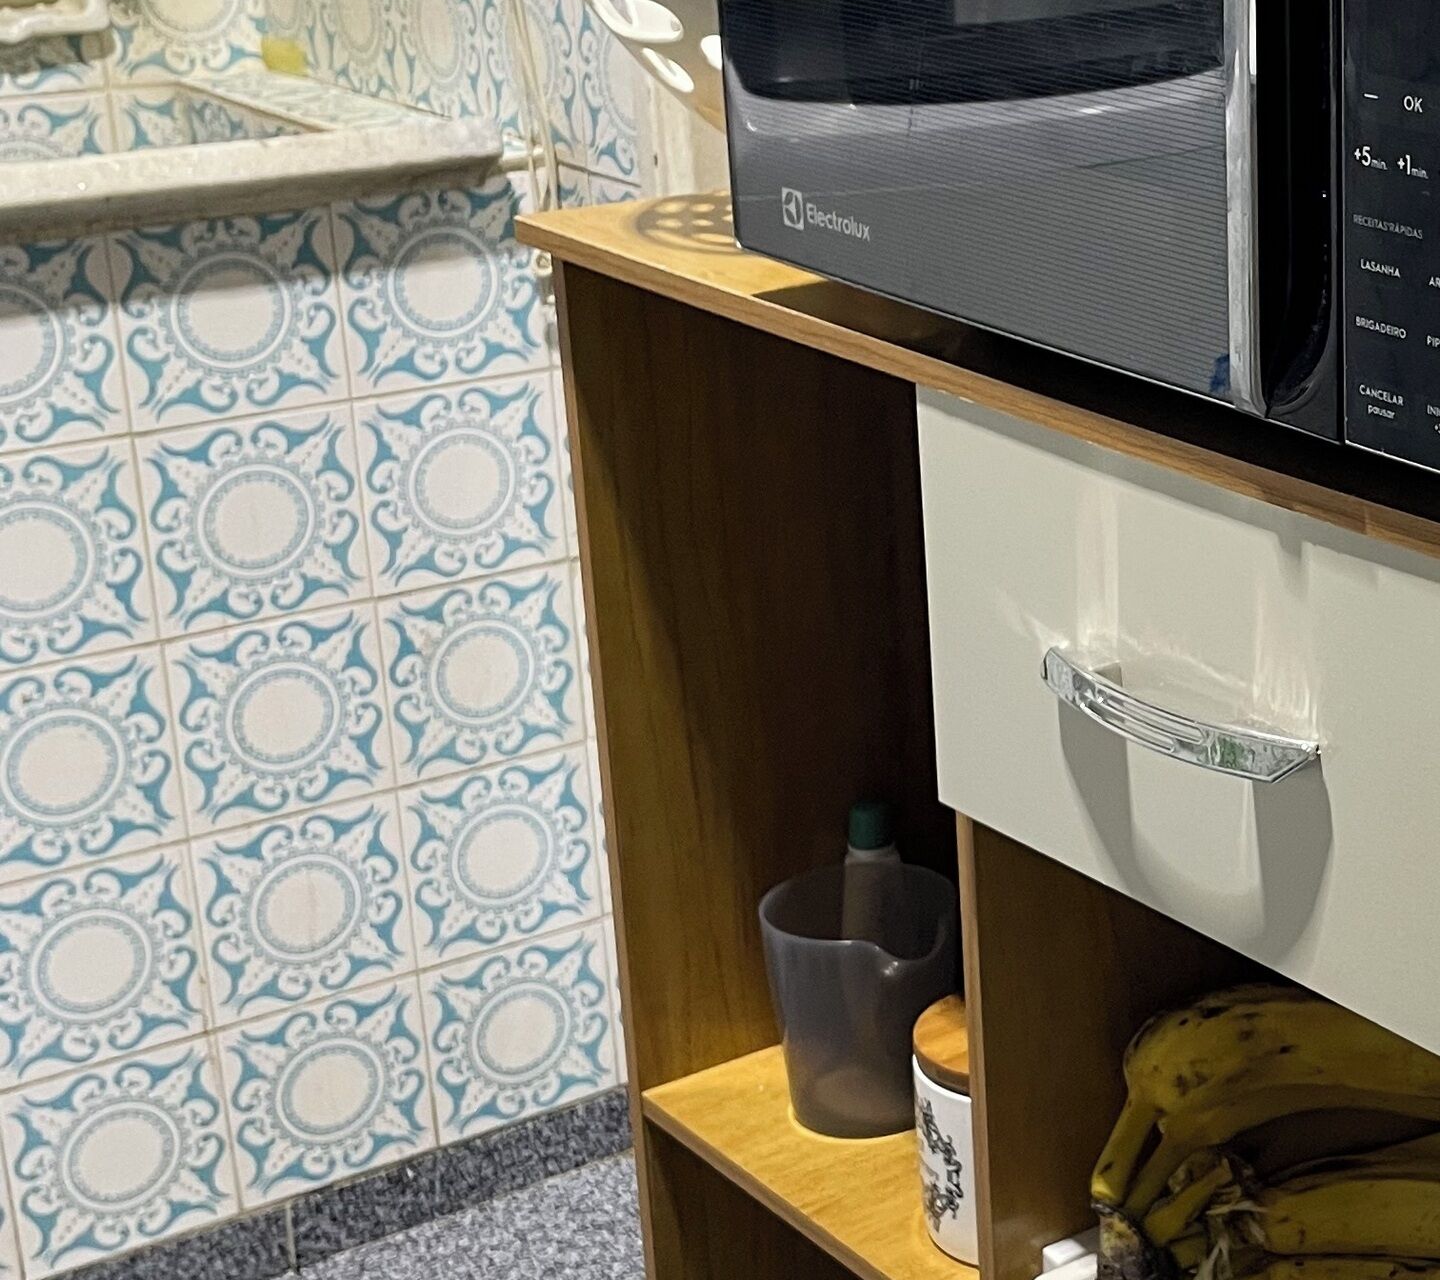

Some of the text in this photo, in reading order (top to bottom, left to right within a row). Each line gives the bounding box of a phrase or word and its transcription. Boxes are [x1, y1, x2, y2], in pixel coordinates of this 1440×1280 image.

[1403, 95, 1423, 113] OK
[806, 202, 870, 242] Electrolux
[1360, 258, 1401, 278] LASANHA
[1355, 315, 1407, 339] BRIGADEIRO
[1359, 384, 1404, 406] CANCELAR
